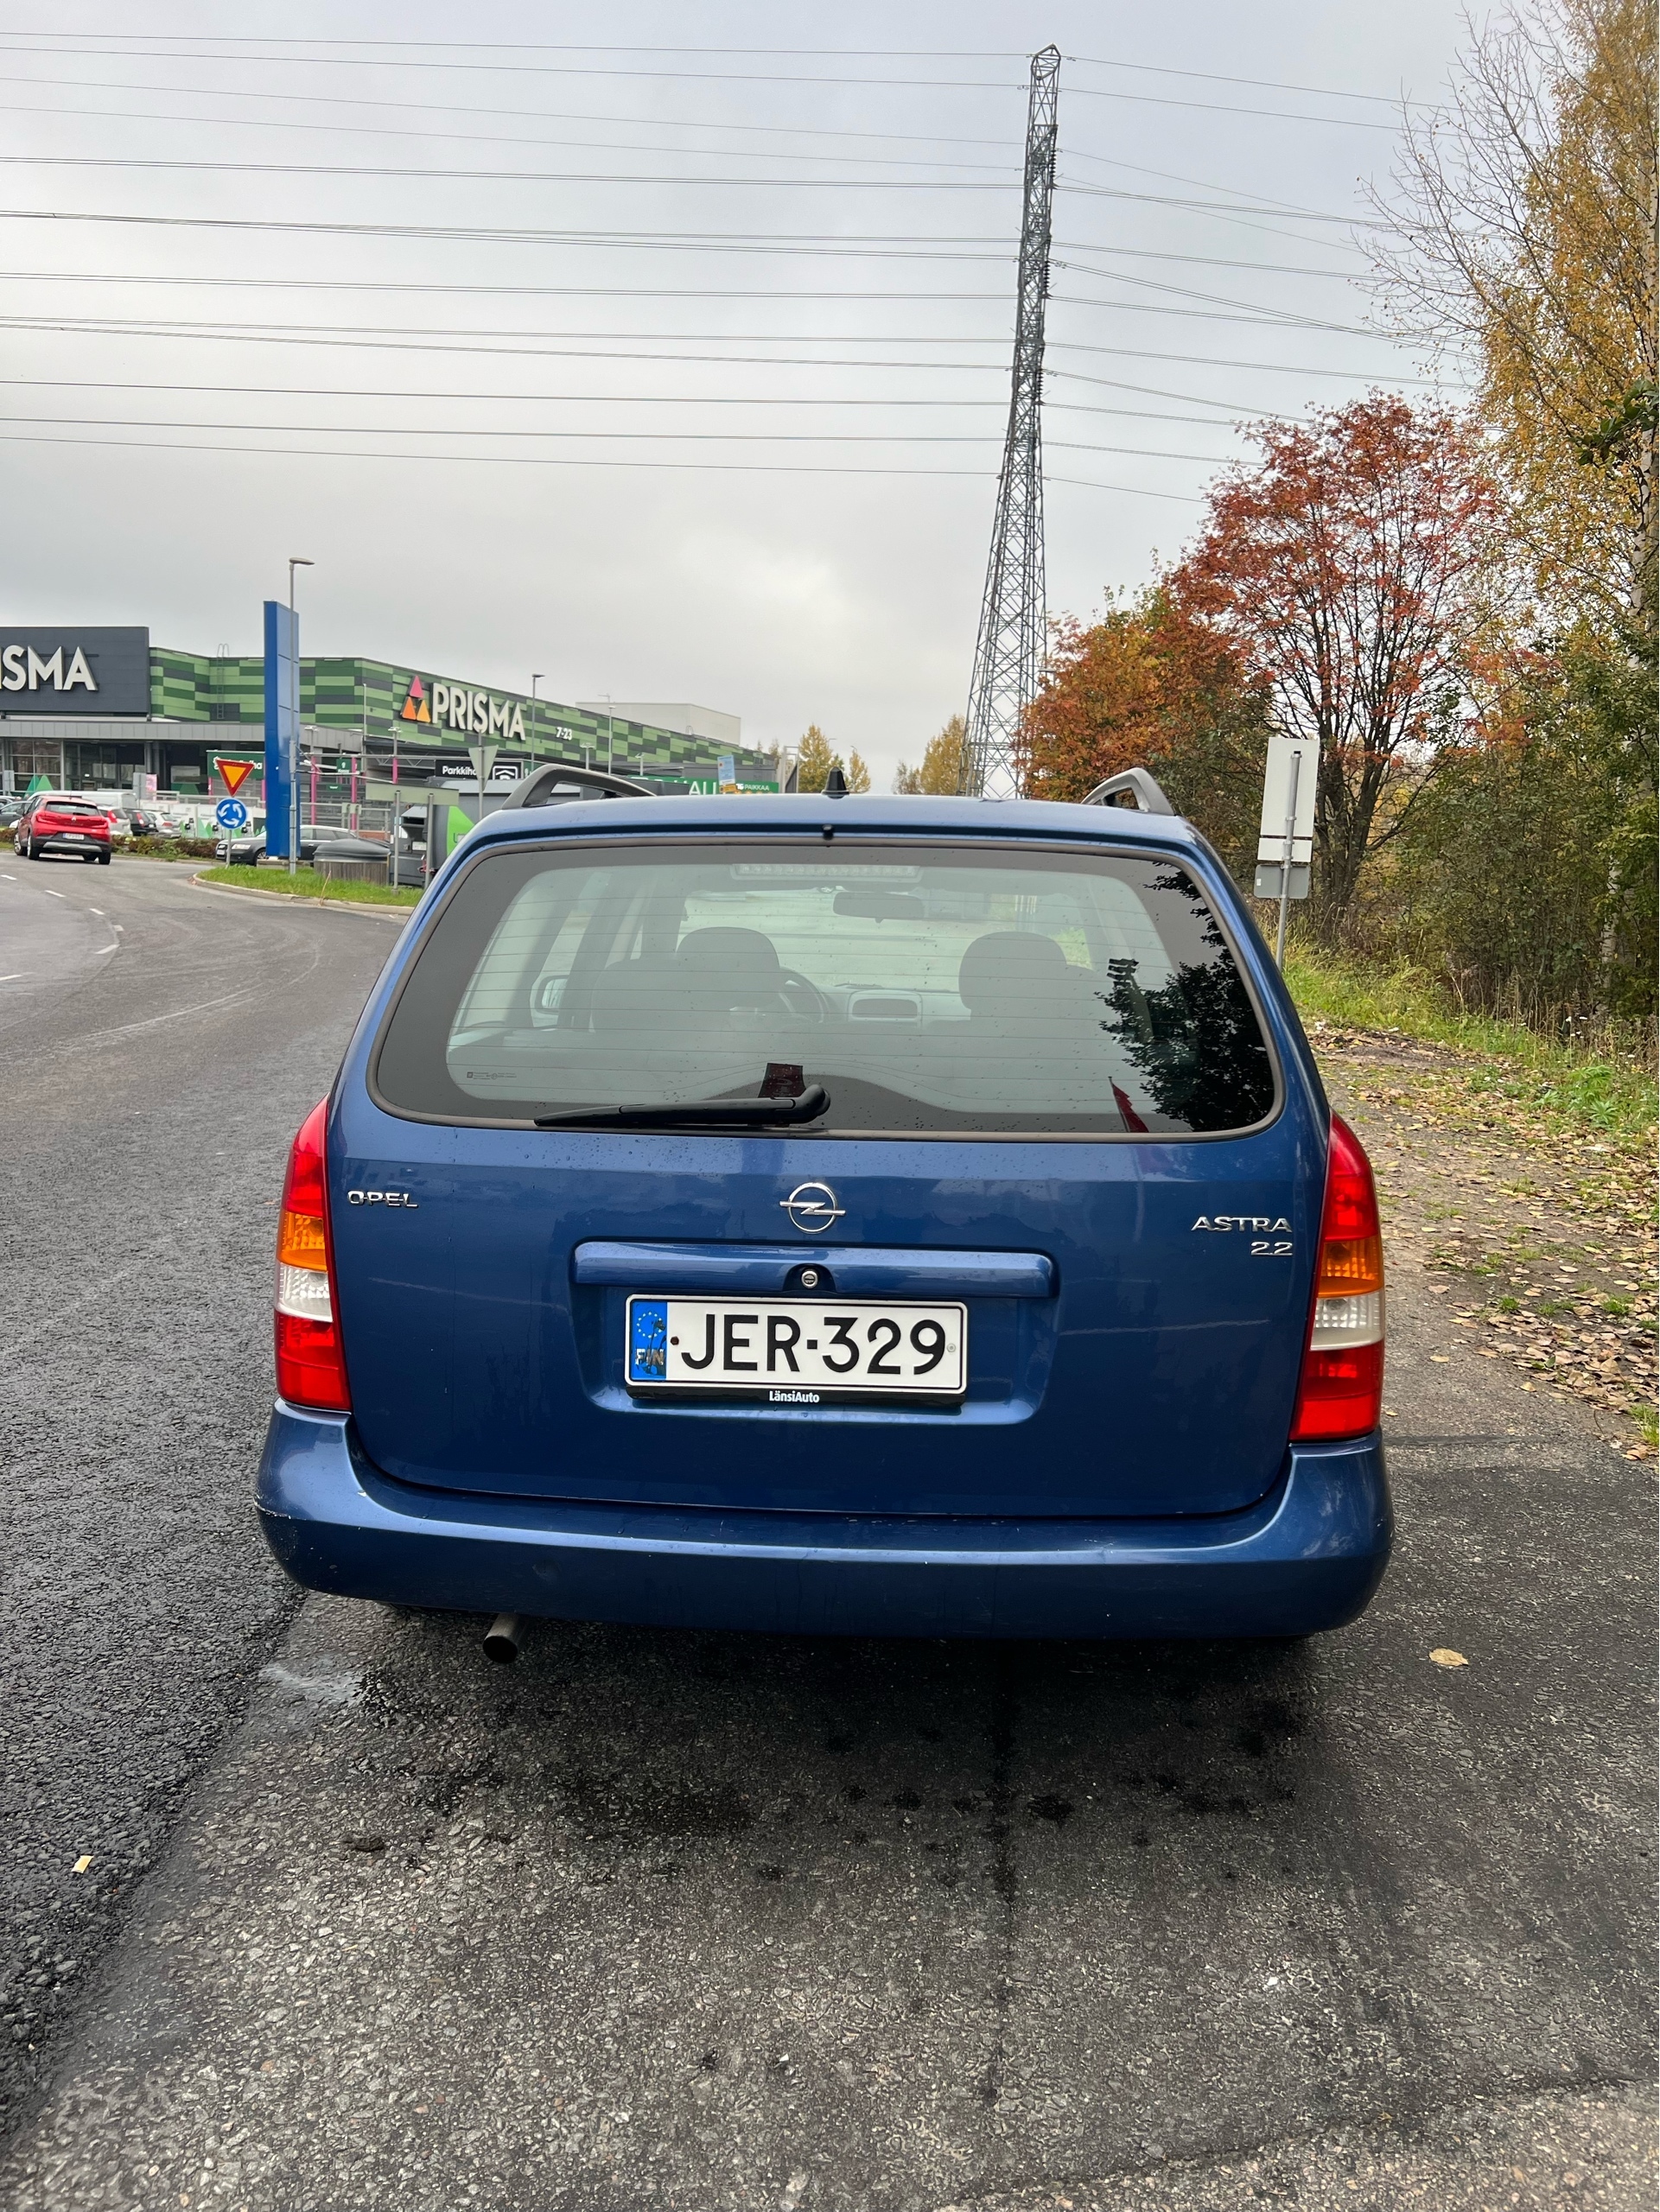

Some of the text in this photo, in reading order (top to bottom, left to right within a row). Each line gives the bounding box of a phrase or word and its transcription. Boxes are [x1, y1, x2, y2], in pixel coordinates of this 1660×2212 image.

[0, 645, 98, 691] SMA
[432, 682, 526, 741] PRISMA
[347, 1191, 418, 1207] OPEL
[1191, 1216, 1293, 1233] ASTRA
[1250, 1242, 1293, 1256] 2.2
[634, 1313, 946, 1376] FIN JER-329
[769, 1390, 820, 1403] LänsiAuto
